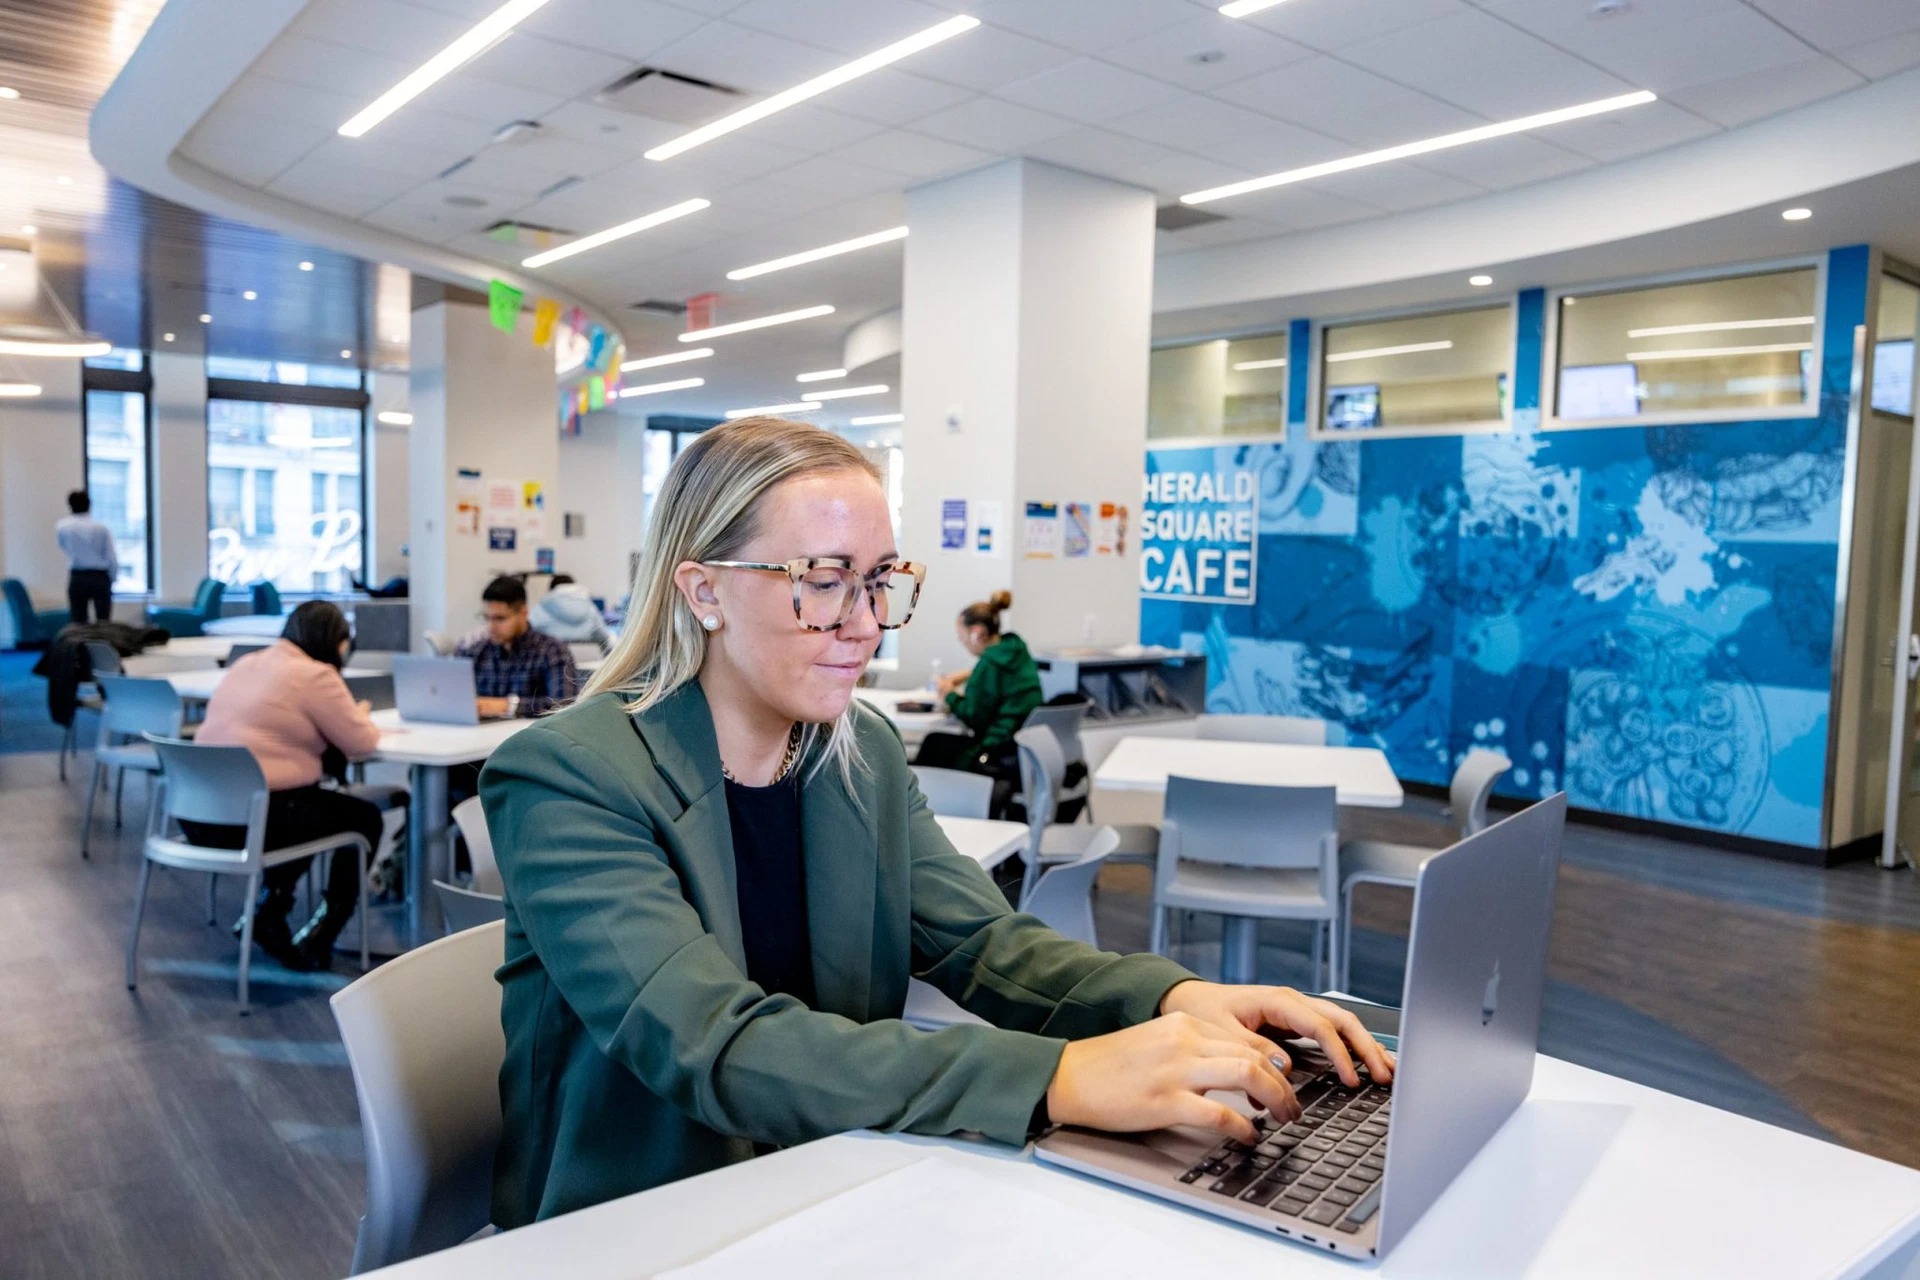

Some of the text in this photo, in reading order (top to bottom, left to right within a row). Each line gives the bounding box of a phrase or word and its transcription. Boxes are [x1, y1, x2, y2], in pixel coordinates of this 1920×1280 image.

[1142, 472, 1253, 503] HERALD
[1141, 510, 1251, 542] SQUARE
[1140, 547, 1252, 597] CAFE
